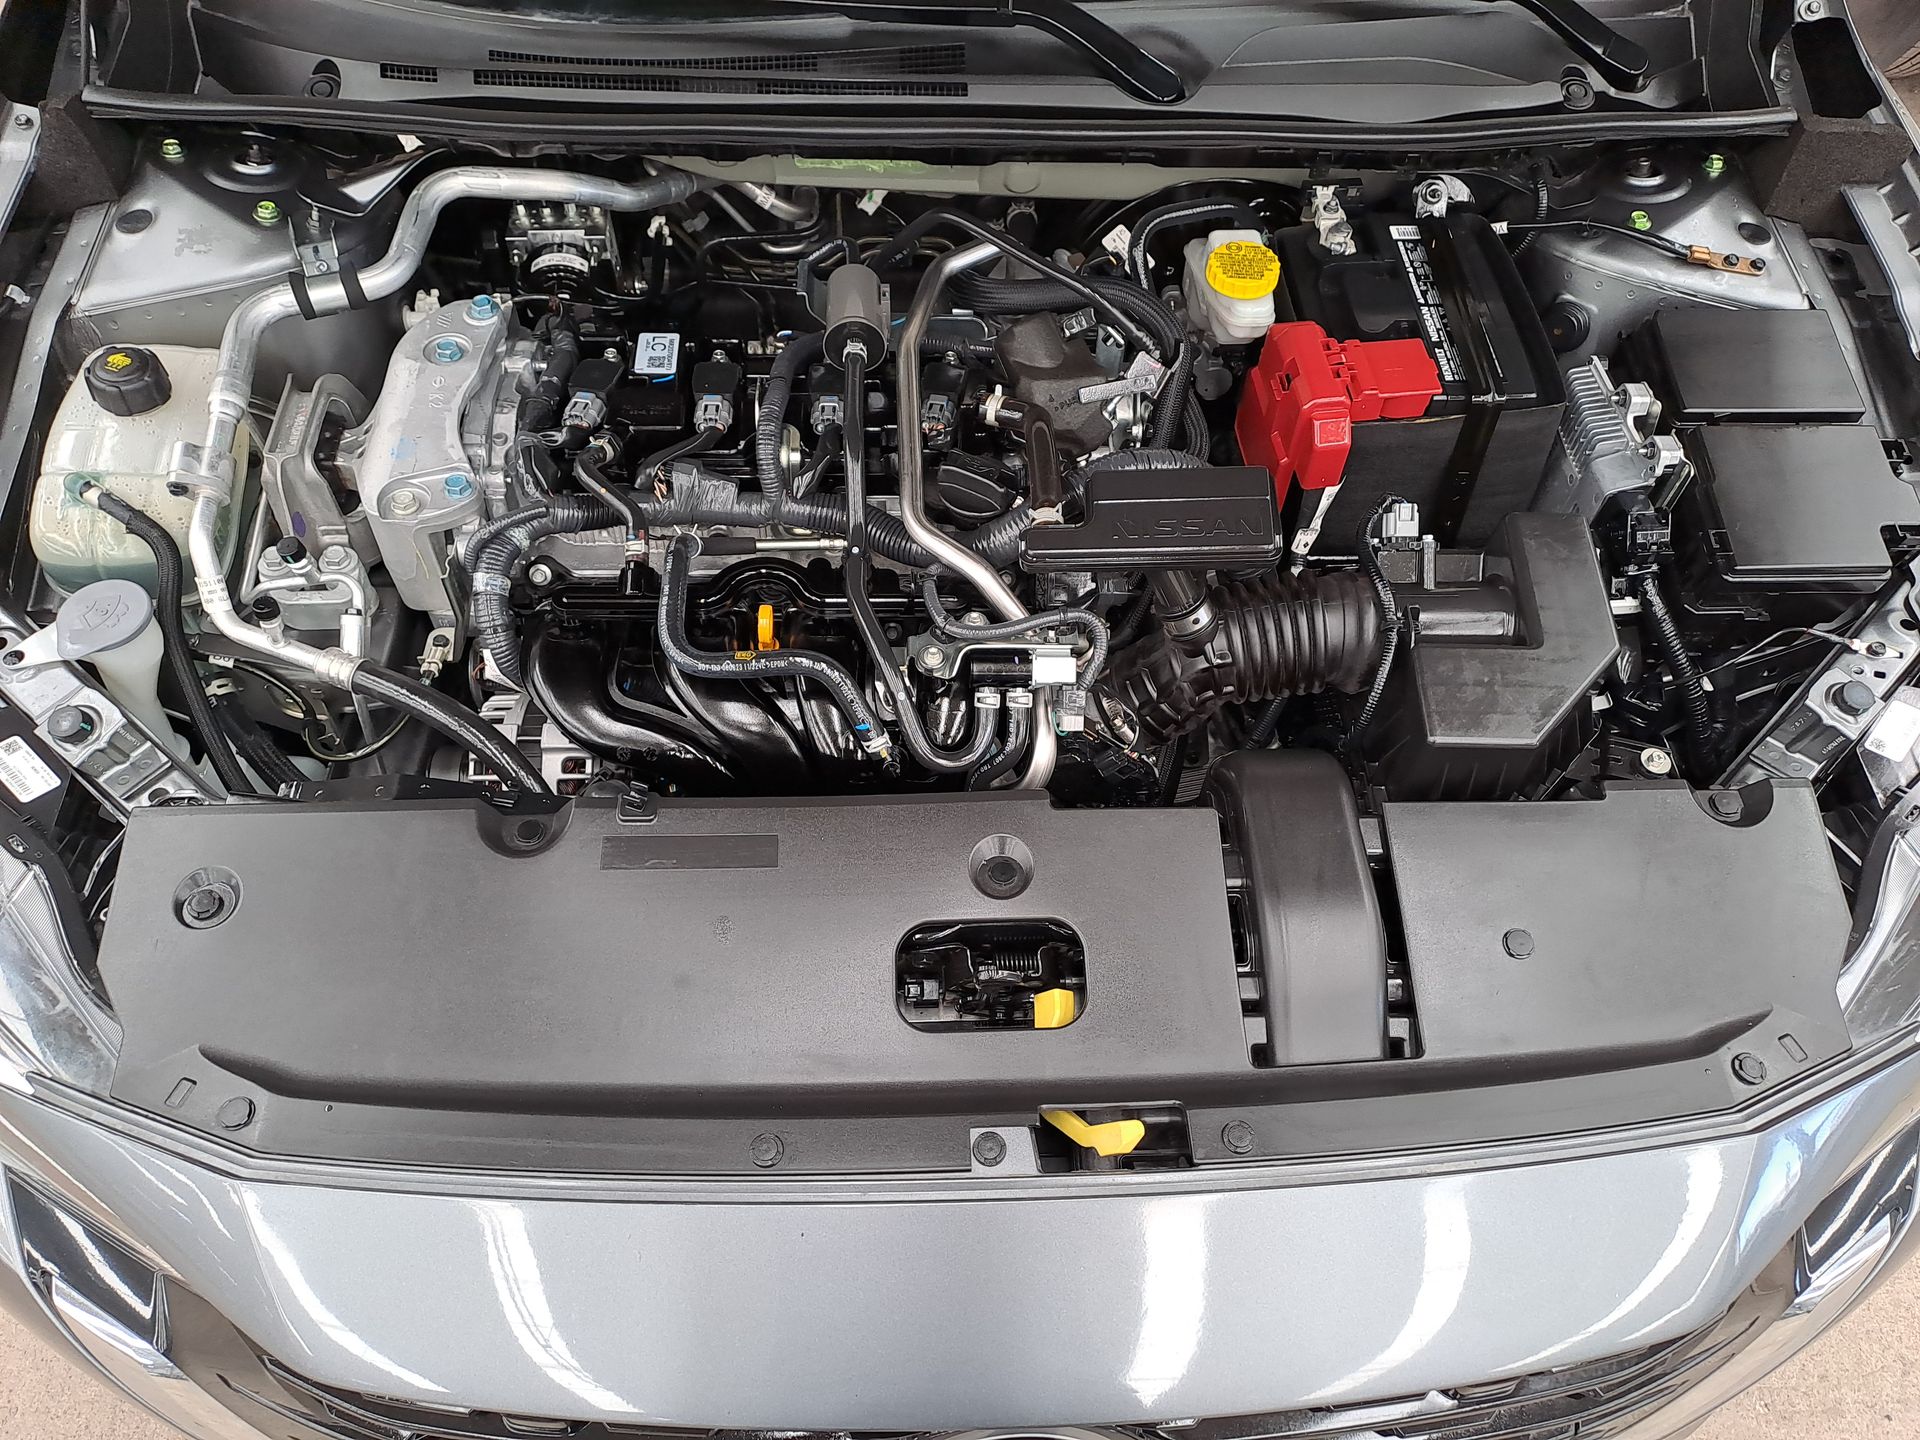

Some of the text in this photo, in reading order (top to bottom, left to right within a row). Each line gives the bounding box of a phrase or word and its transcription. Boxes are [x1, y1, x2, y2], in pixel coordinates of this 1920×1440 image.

[1420, 306, 1440, 342] NISSAN
[651, 335, 668, 352] LC
[1434, 347, 1455, 382] RENAULT
[1112, 515, 1264, 540] NISSAN
